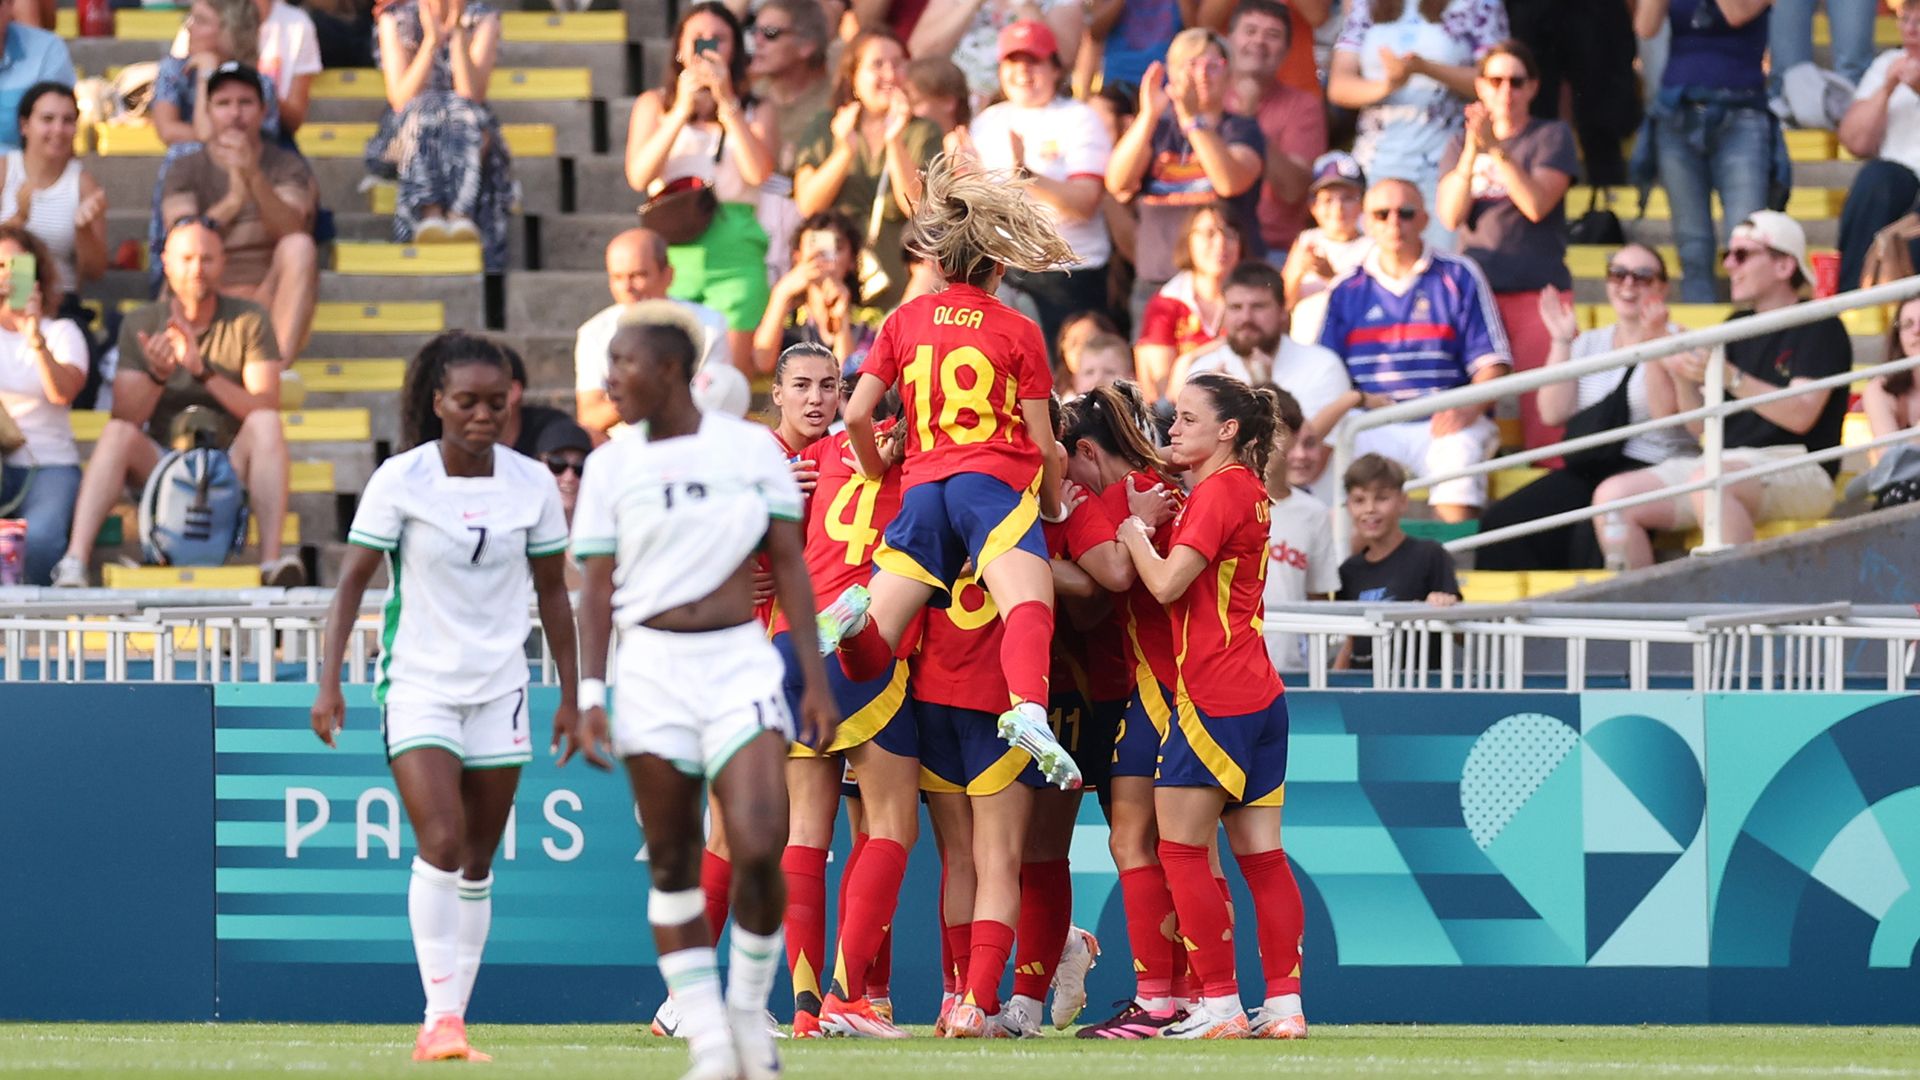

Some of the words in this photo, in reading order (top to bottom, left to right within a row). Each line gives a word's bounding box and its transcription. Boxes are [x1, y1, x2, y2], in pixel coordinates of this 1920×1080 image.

[933, 305, 984, 329] OLGA
[903, 344, 998, 452] 18
[824, 472, 881, 566] 4
[467, 526, 490, 566] 7
[512, 687, 524, 731] 7
[1047, 707, 1081, 752] 11
[286, 787, 585, 862] PAIS
